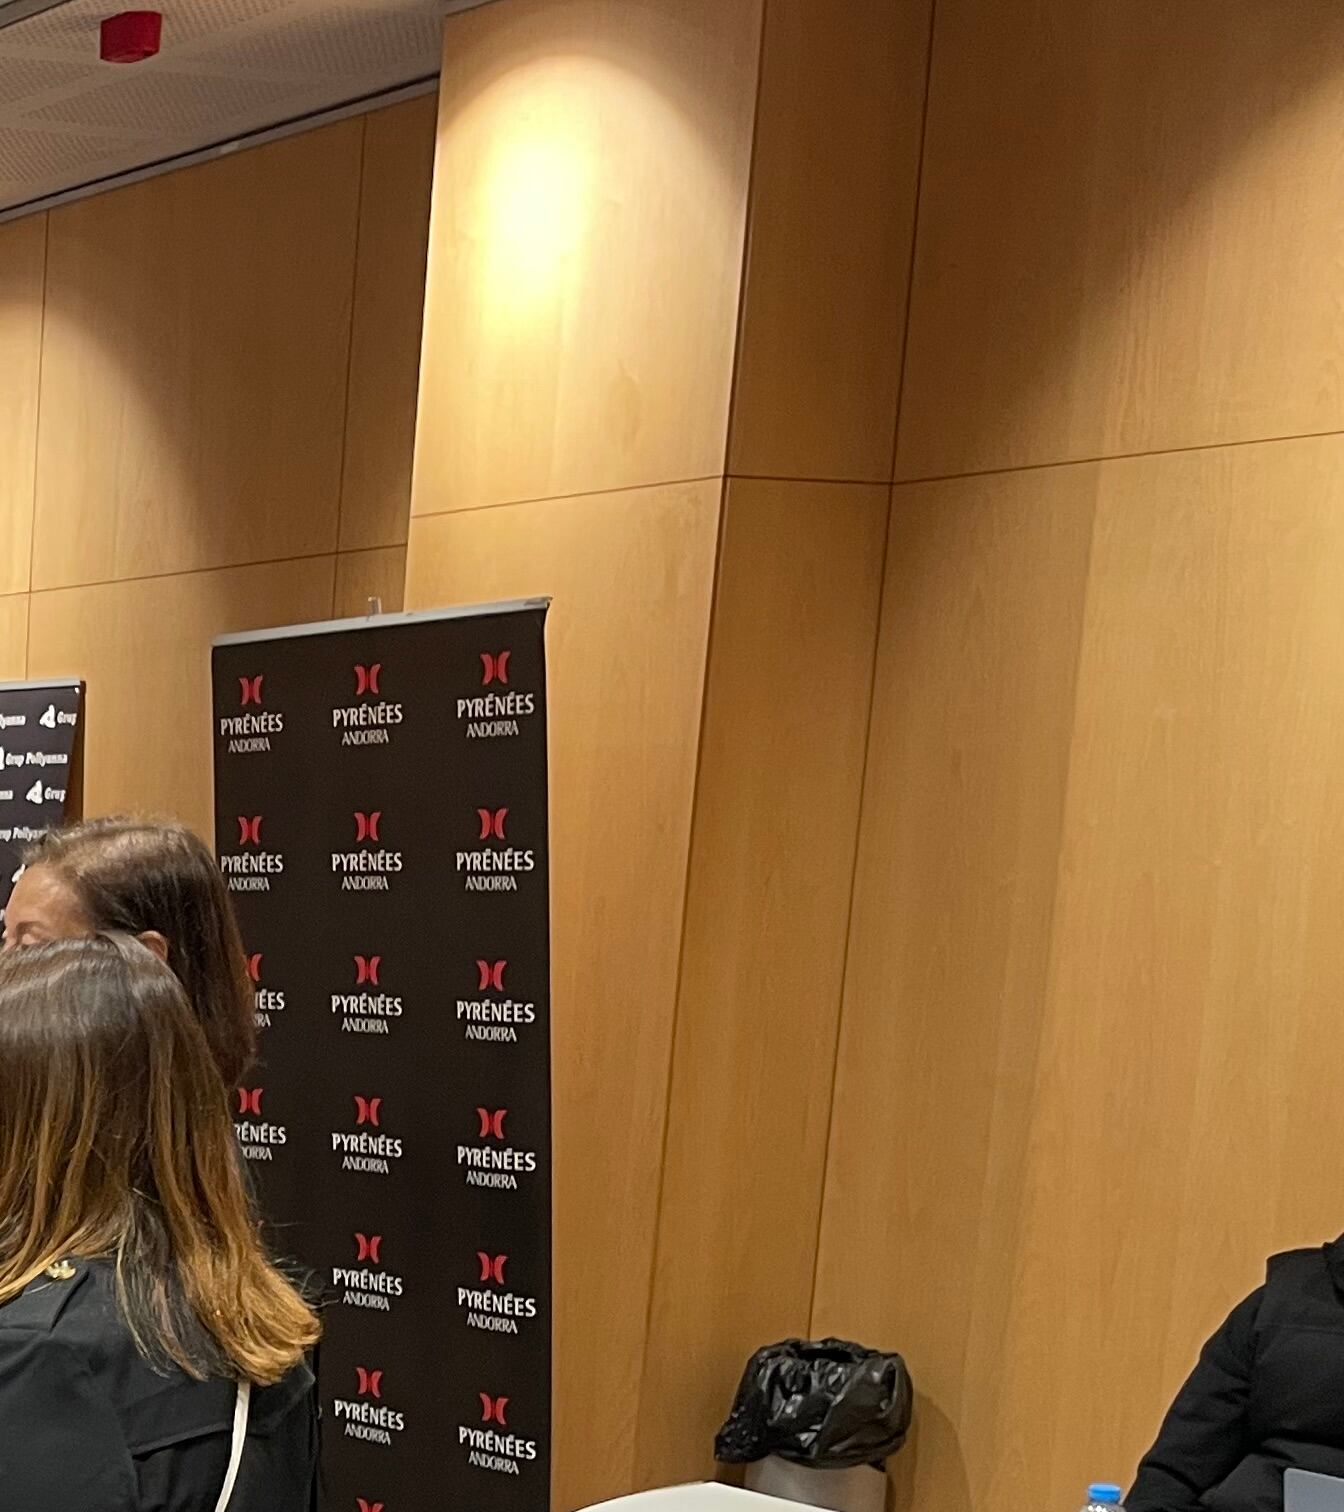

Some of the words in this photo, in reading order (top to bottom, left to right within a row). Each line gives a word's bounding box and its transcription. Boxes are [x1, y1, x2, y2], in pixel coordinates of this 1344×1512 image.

[332, 701, 403, 728] PYRÉNÉES
[457, 692, 534, 718] PYRÉNÉES
[220, 712, 283, 736] PYRÉNÉES
[466, 719, 519, 738] ANDORRA
[228, 737, 271, 753] ANDORRA
[342, 728, 389, 746] ANDORRA
[221, 851, 284, 873] PYRÉNÉES
[332, 849, 403, 872] PYRÉNÉES
[456, 848, 535, 871] PYRÉNÉES
[227, 876, 270, 891] ANDORRA
[342, 875, 389, 890] ANDORRA
[465, 875, 518, 891] ANDORRA
[331, 992, 403, 1016] PYRÉNÉES
[456, 999, 535, 1023] PYRÉNÉES
[342, 1017, 389, 1034] ANDORRA
[465, 1024, 518, 1042] ANDORRA
[332, 1132, 403, 1159] PYRÉNÉES
[342, 1155, 389, 1175] ANDORRA
[457, 1145, 536, 1173] PYRÉNÉES
[466, 1172, 518, 1190] ANDORRA
[332, 1267, 403, 1297] PYRÉNÉES
[343, 1290, 390, 1312] ANDORRA
[457, 1287, 537, 1319] PYRÉNÉES
[467, 1313, 518, 1335] ANDORRA
[334, 1399, 405, 1432] PYRÉNÉES
[344, 1422, 391, 1446] ANDORRA
[458, 1426, 537, 1461] PYRÉNÉES
[468, 1450, 520, 1475] ANDORRA
